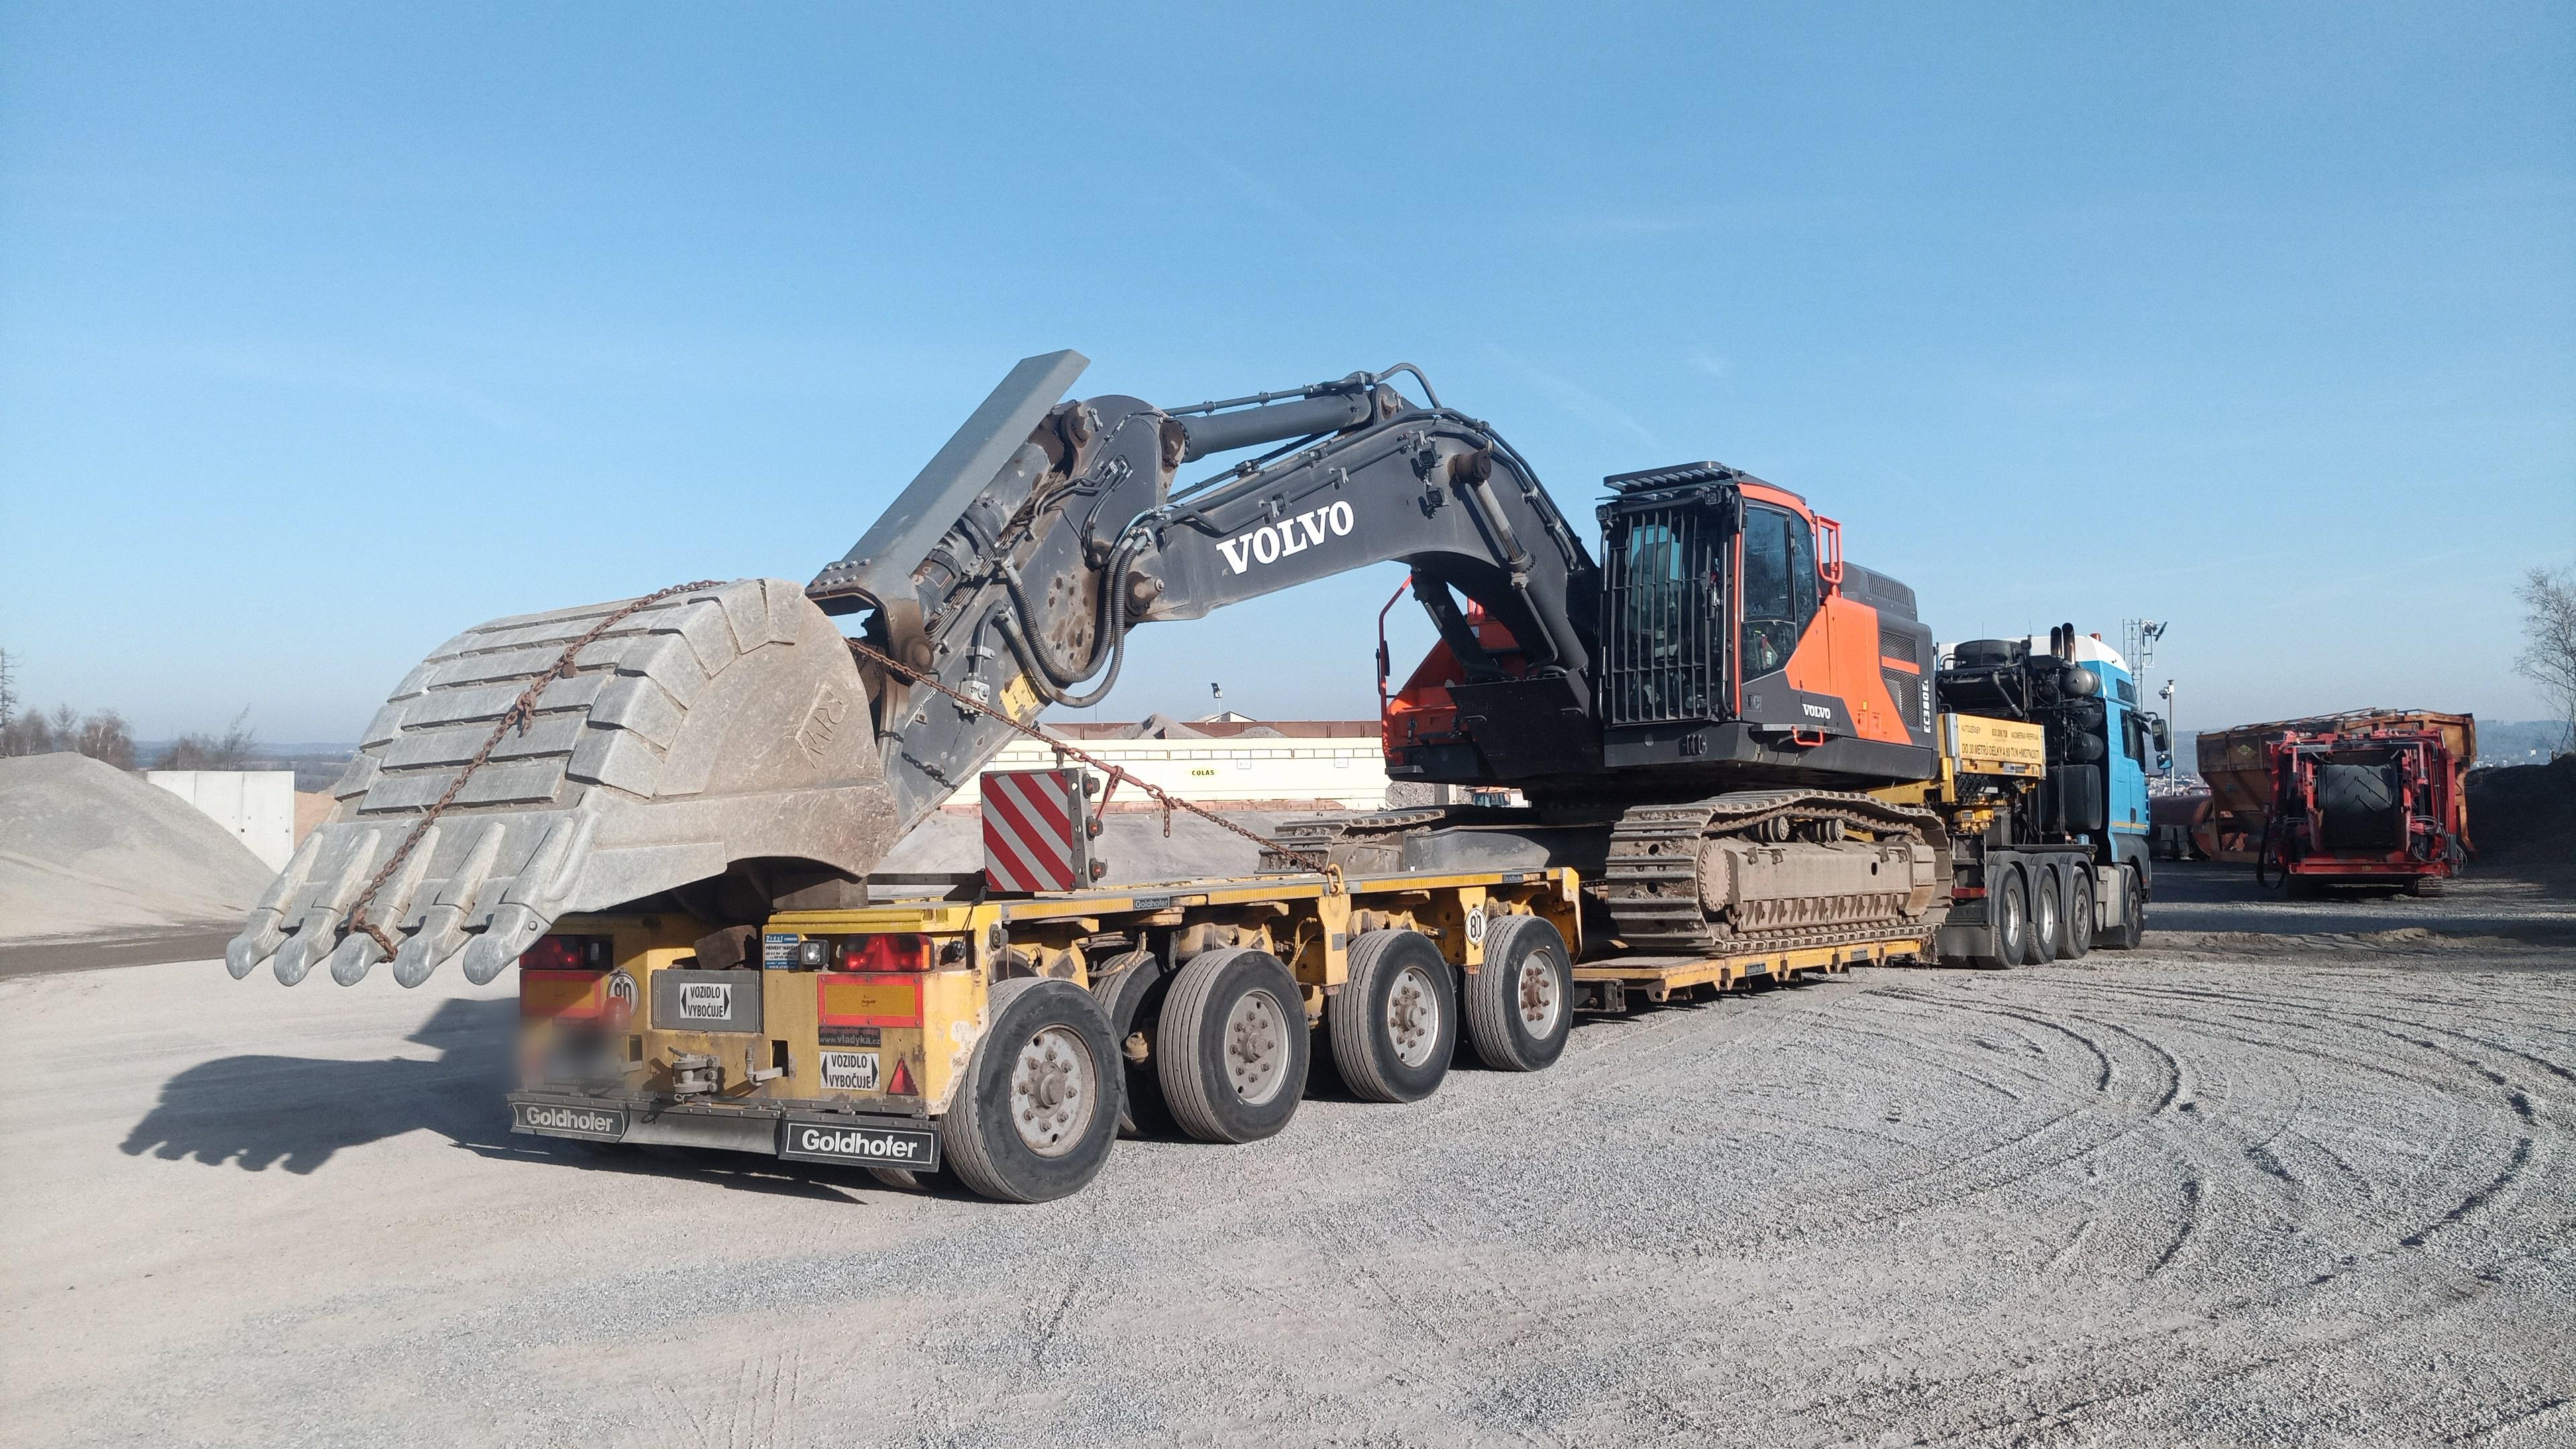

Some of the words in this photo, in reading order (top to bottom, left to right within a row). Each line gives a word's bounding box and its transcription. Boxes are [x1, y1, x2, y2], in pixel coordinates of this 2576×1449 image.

[1216, 500, 1355, 575] VOLVO
[1802, 704, 1831, 719] VOLVO
[1962, 743, 1968, 753] DO
[1136, 900, 1168, 908] Goldhofer
[1470, 915, 1481, 938] 80
[690, 986, 720, 999] VOZIDLO
[688, 1003, 723, 1017] VYBOČUJE
[820, 1034, 880, 1045] www.vladyka.cz
[831, 1055, 867, 1069] VOZIDLO
[829, 1073, 871, 1089] VYBOČUJE
[526, 1106, 613, 1132] Goldhofer
[802, 1129, 918, 1158] Goldhofer
